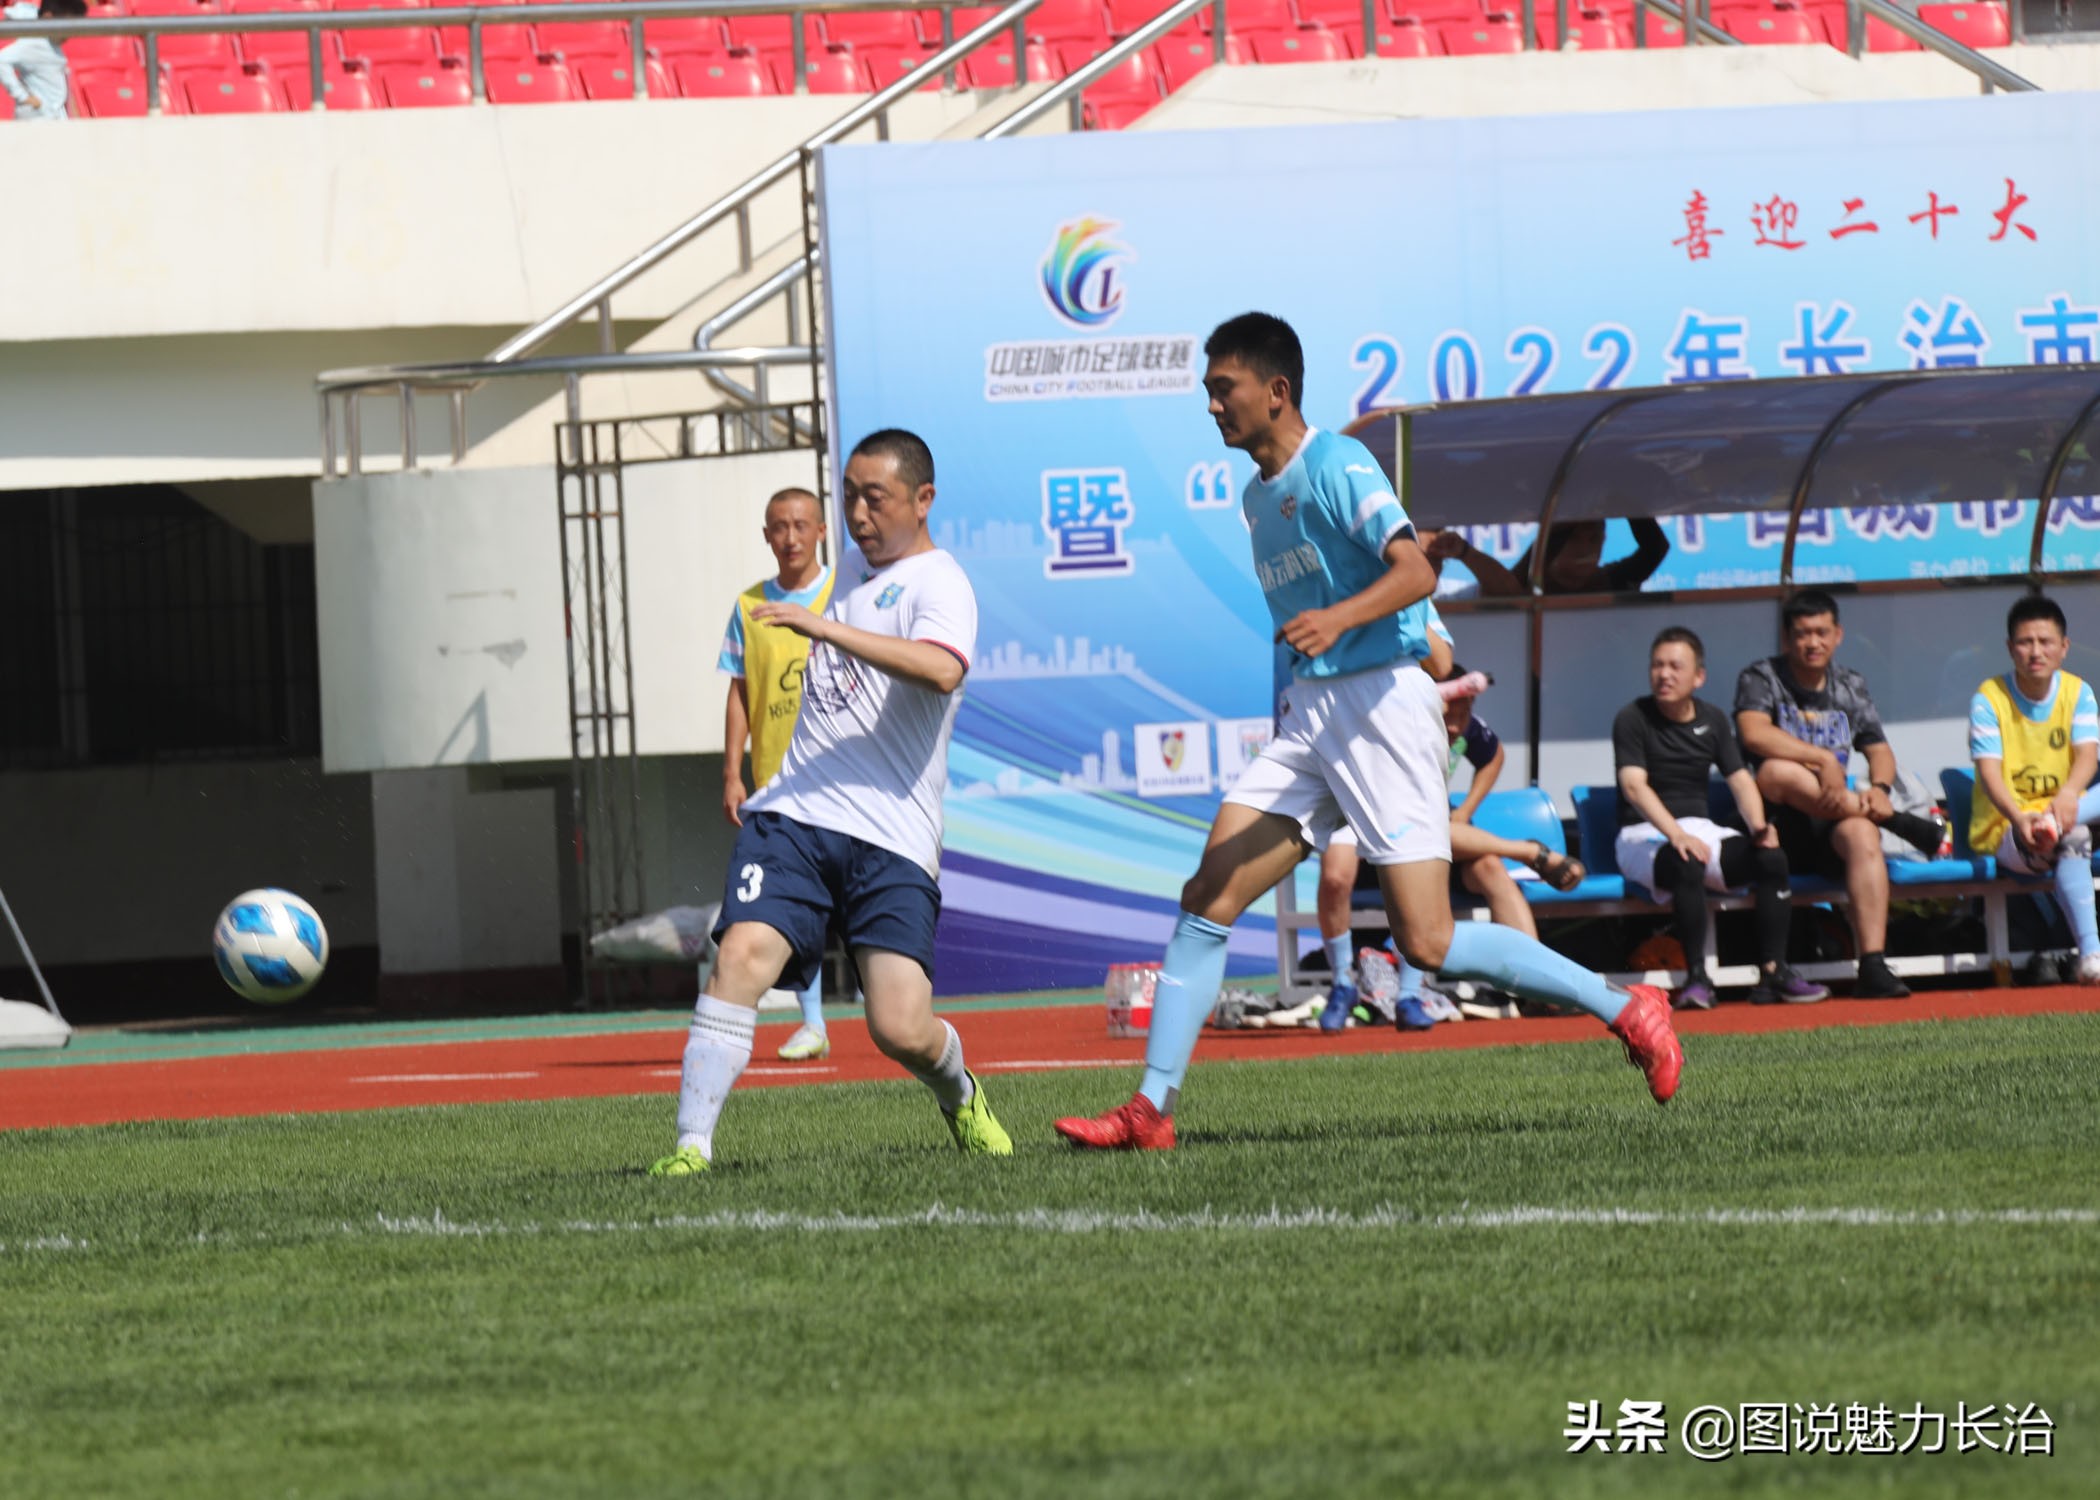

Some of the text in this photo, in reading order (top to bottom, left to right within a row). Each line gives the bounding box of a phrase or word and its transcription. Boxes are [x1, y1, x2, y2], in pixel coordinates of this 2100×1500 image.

[1673, 177, 2037, 261] 喜迎二十大
[990, 340, 1193, 376] 中国城市足球联赛
[989, 376, 1192, 396] CHINA CITY FOOTBALL LEAGUE
[736, 863, 764, 903] 3
